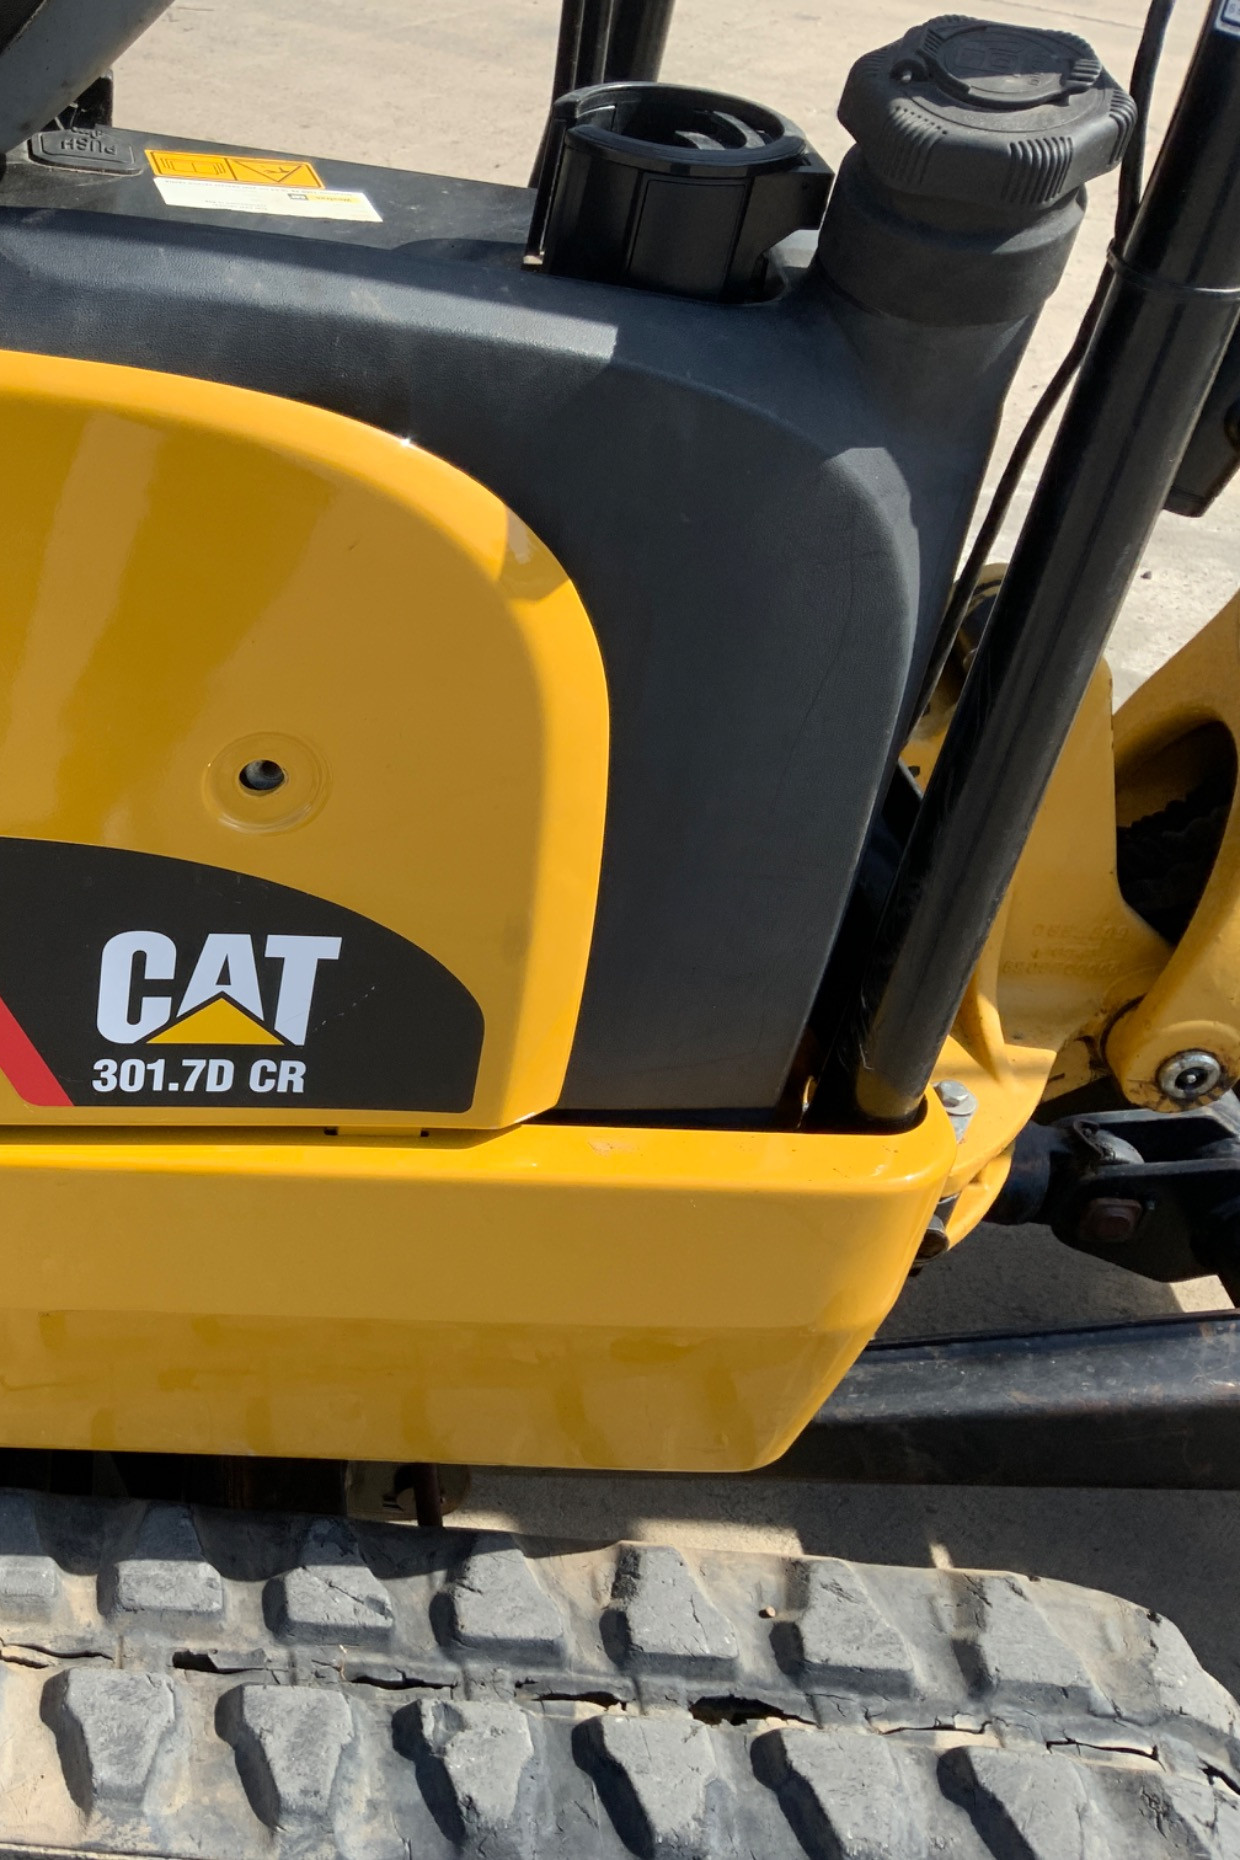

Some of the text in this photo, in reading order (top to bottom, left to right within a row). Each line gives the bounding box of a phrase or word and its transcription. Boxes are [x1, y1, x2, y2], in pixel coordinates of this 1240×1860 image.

[60, 138, 117, 156] PUSH
[96, 930, 342, 1046] CAT
[92, 1058, 306, 1094] 301.7D CR
